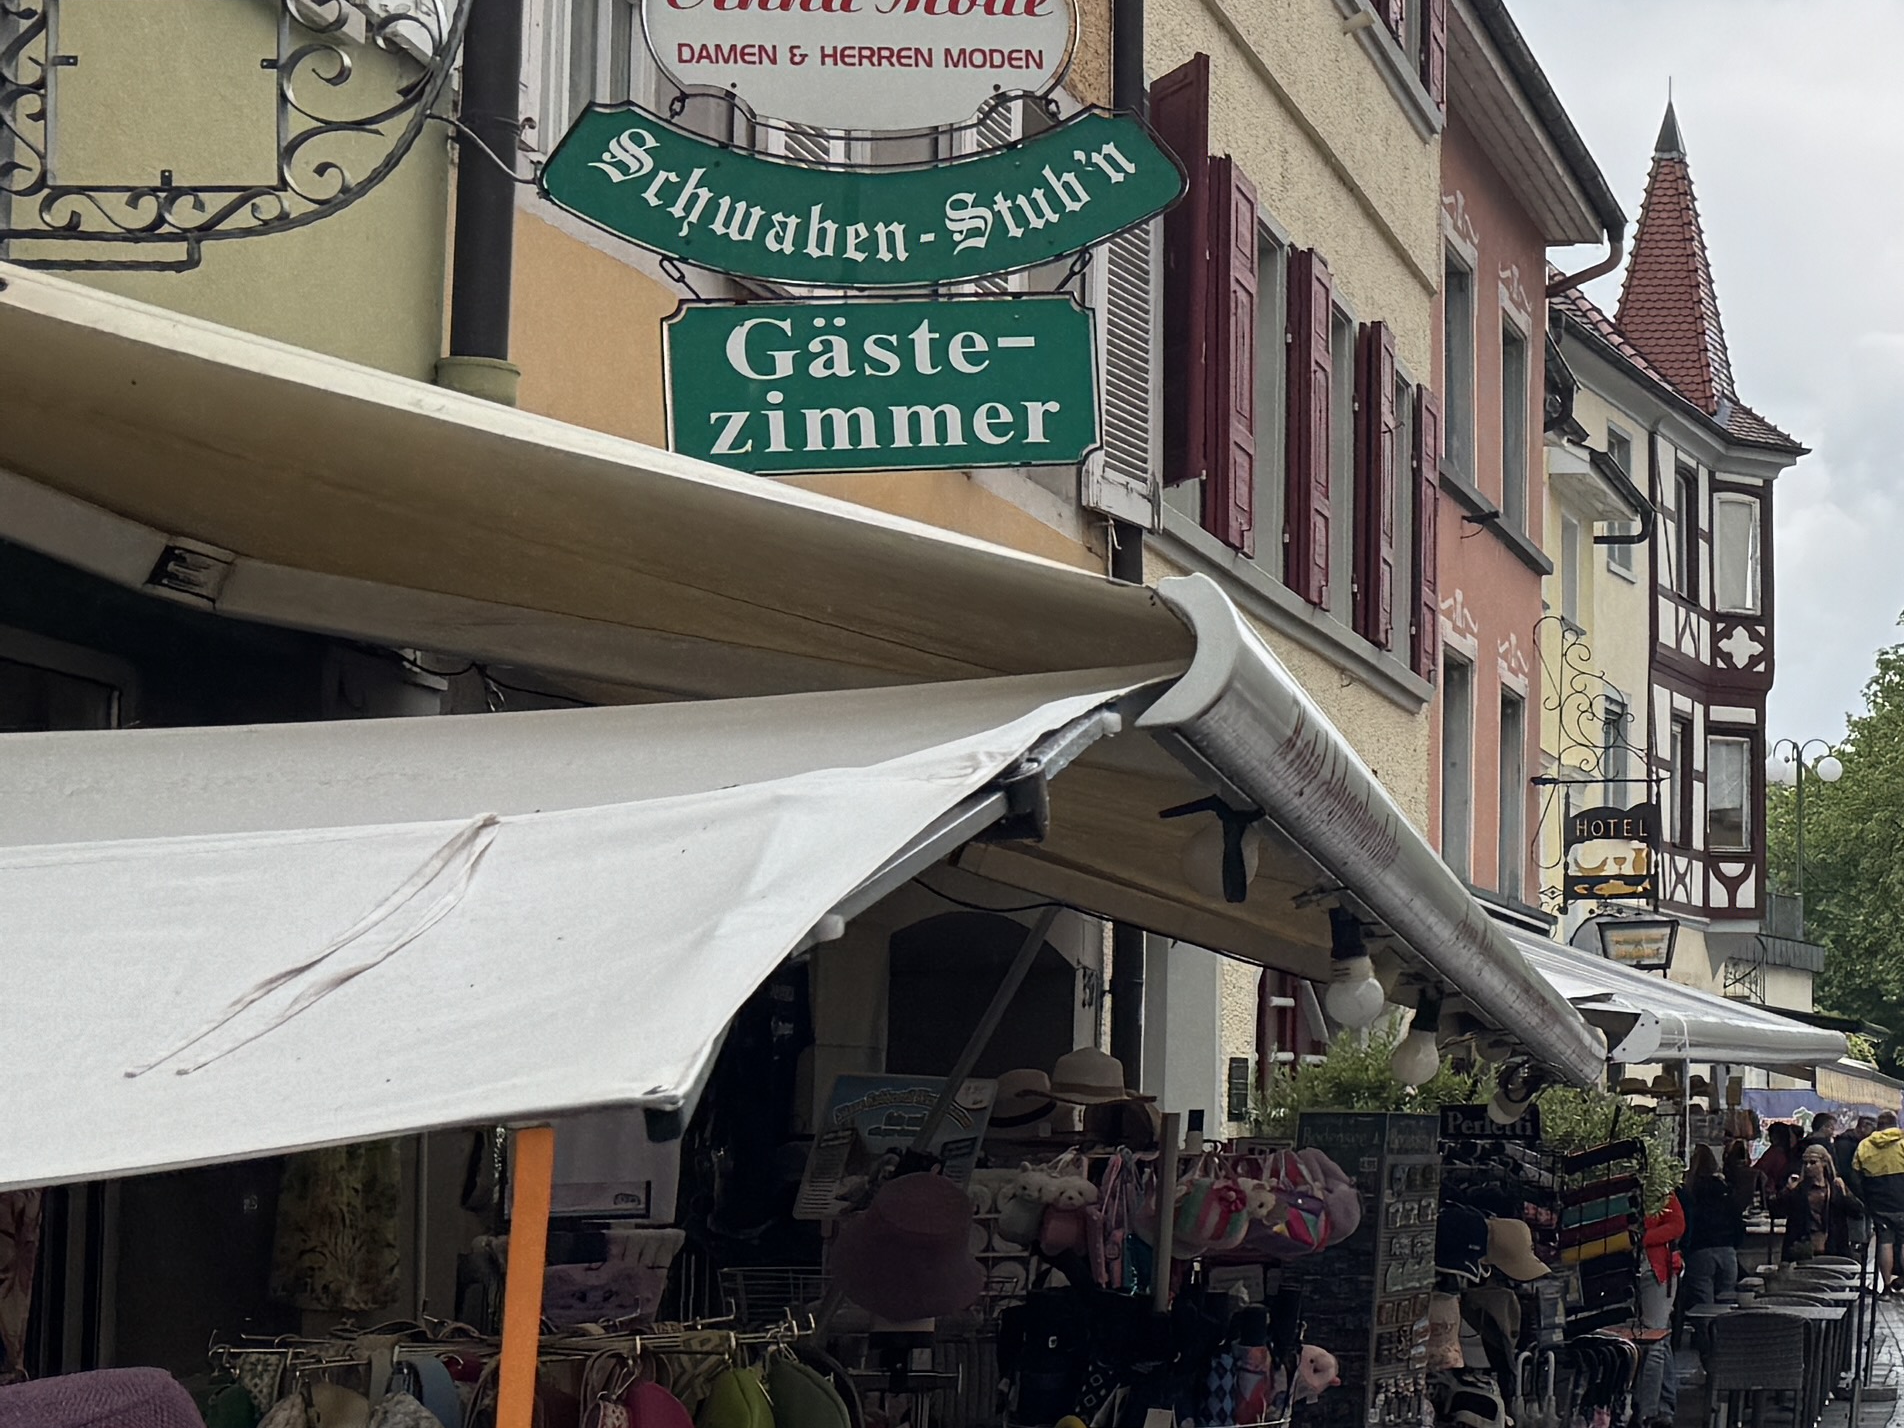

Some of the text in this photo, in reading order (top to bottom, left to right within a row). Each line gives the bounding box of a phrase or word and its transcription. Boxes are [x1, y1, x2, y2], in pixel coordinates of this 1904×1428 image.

[676, 42, 1045, 71] DAMEN & HERREN MODEN
[724, 317, 1038, 381] Gäste-
[708, 390, 1063, 456] zimmer
[1575, 817, 1649, 840] HOTEL
